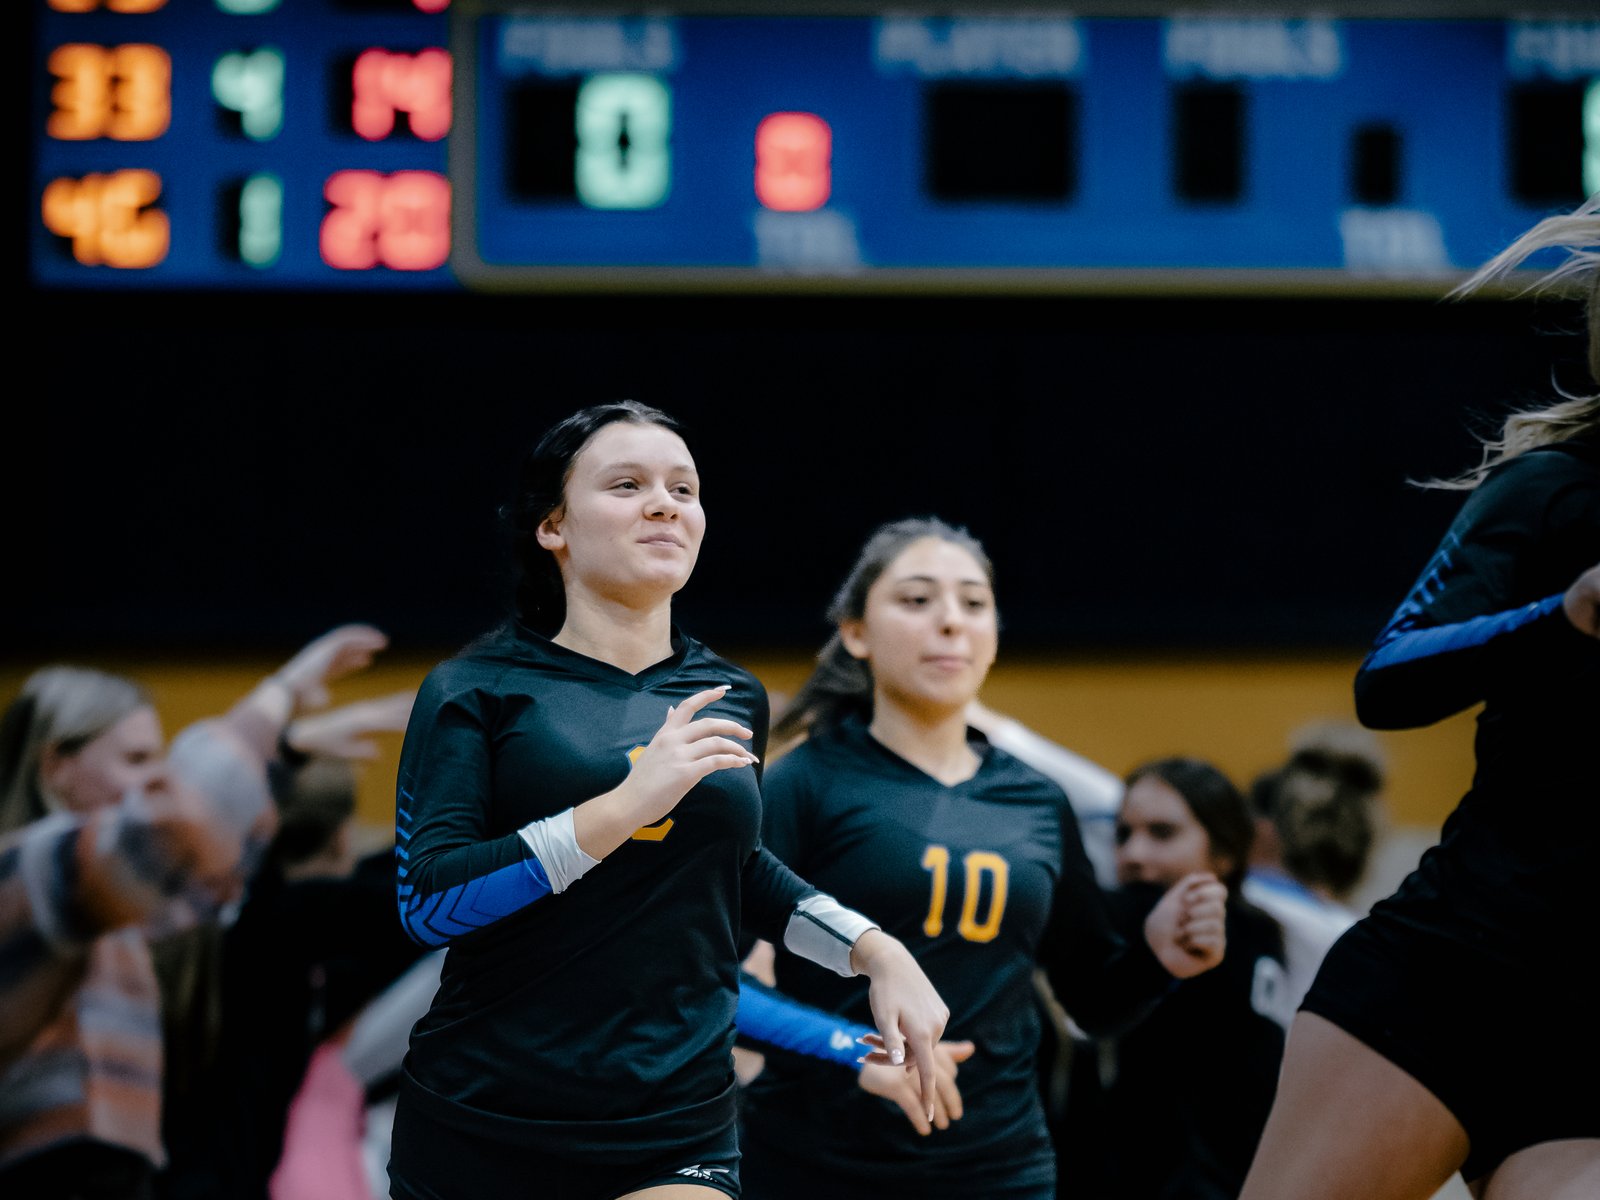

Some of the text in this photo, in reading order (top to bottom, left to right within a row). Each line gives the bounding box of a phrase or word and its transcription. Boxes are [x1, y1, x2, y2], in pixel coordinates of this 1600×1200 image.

[47, 43, 172, 141] 33
[576, 73, 672, 209] 0
[41, 169, 170, 269] 46
[239, 173, 284, 267] 1
[921, 846, 1009, 942] 10
